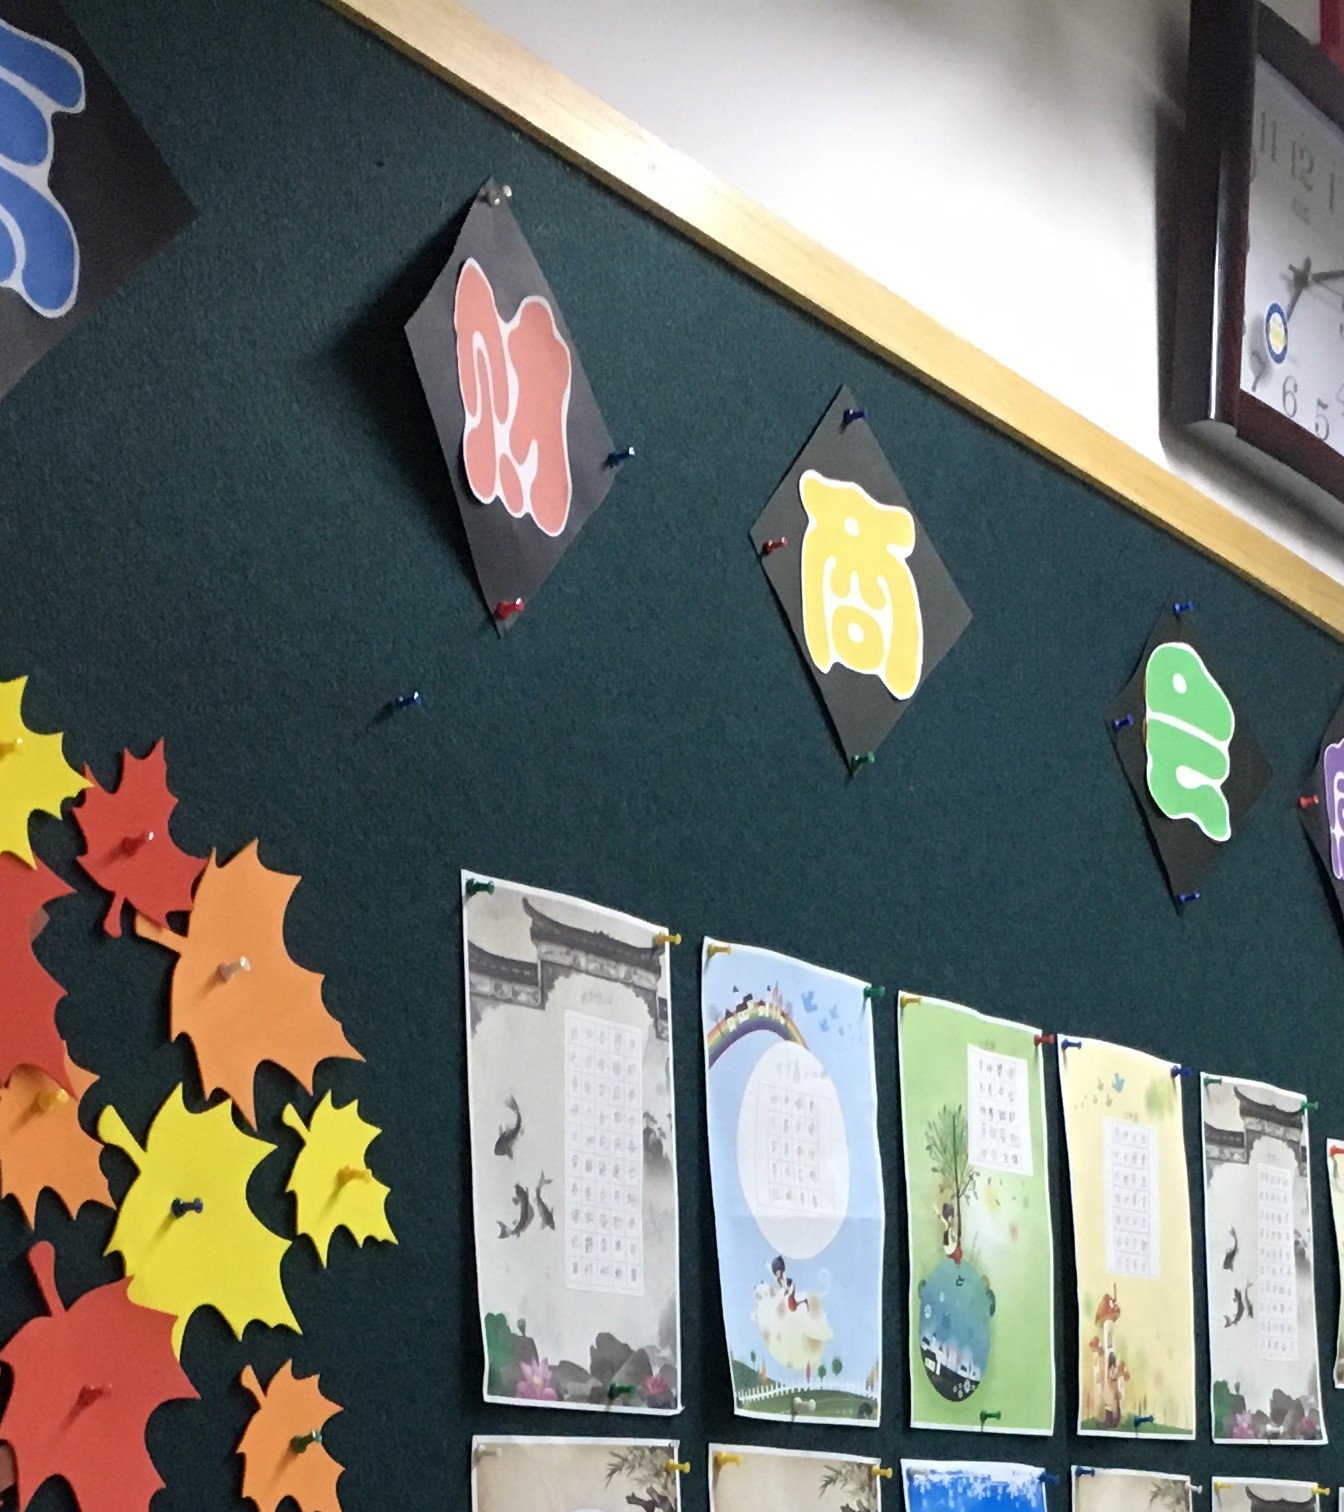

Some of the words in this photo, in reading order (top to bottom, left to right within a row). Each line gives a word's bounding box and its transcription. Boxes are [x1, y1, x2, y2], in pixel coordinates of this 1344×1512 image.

[1290, 139, 1315, 192] 12
[1282, 374, 1299, 418] 6
[1314, 399, 1330, 442] 5
